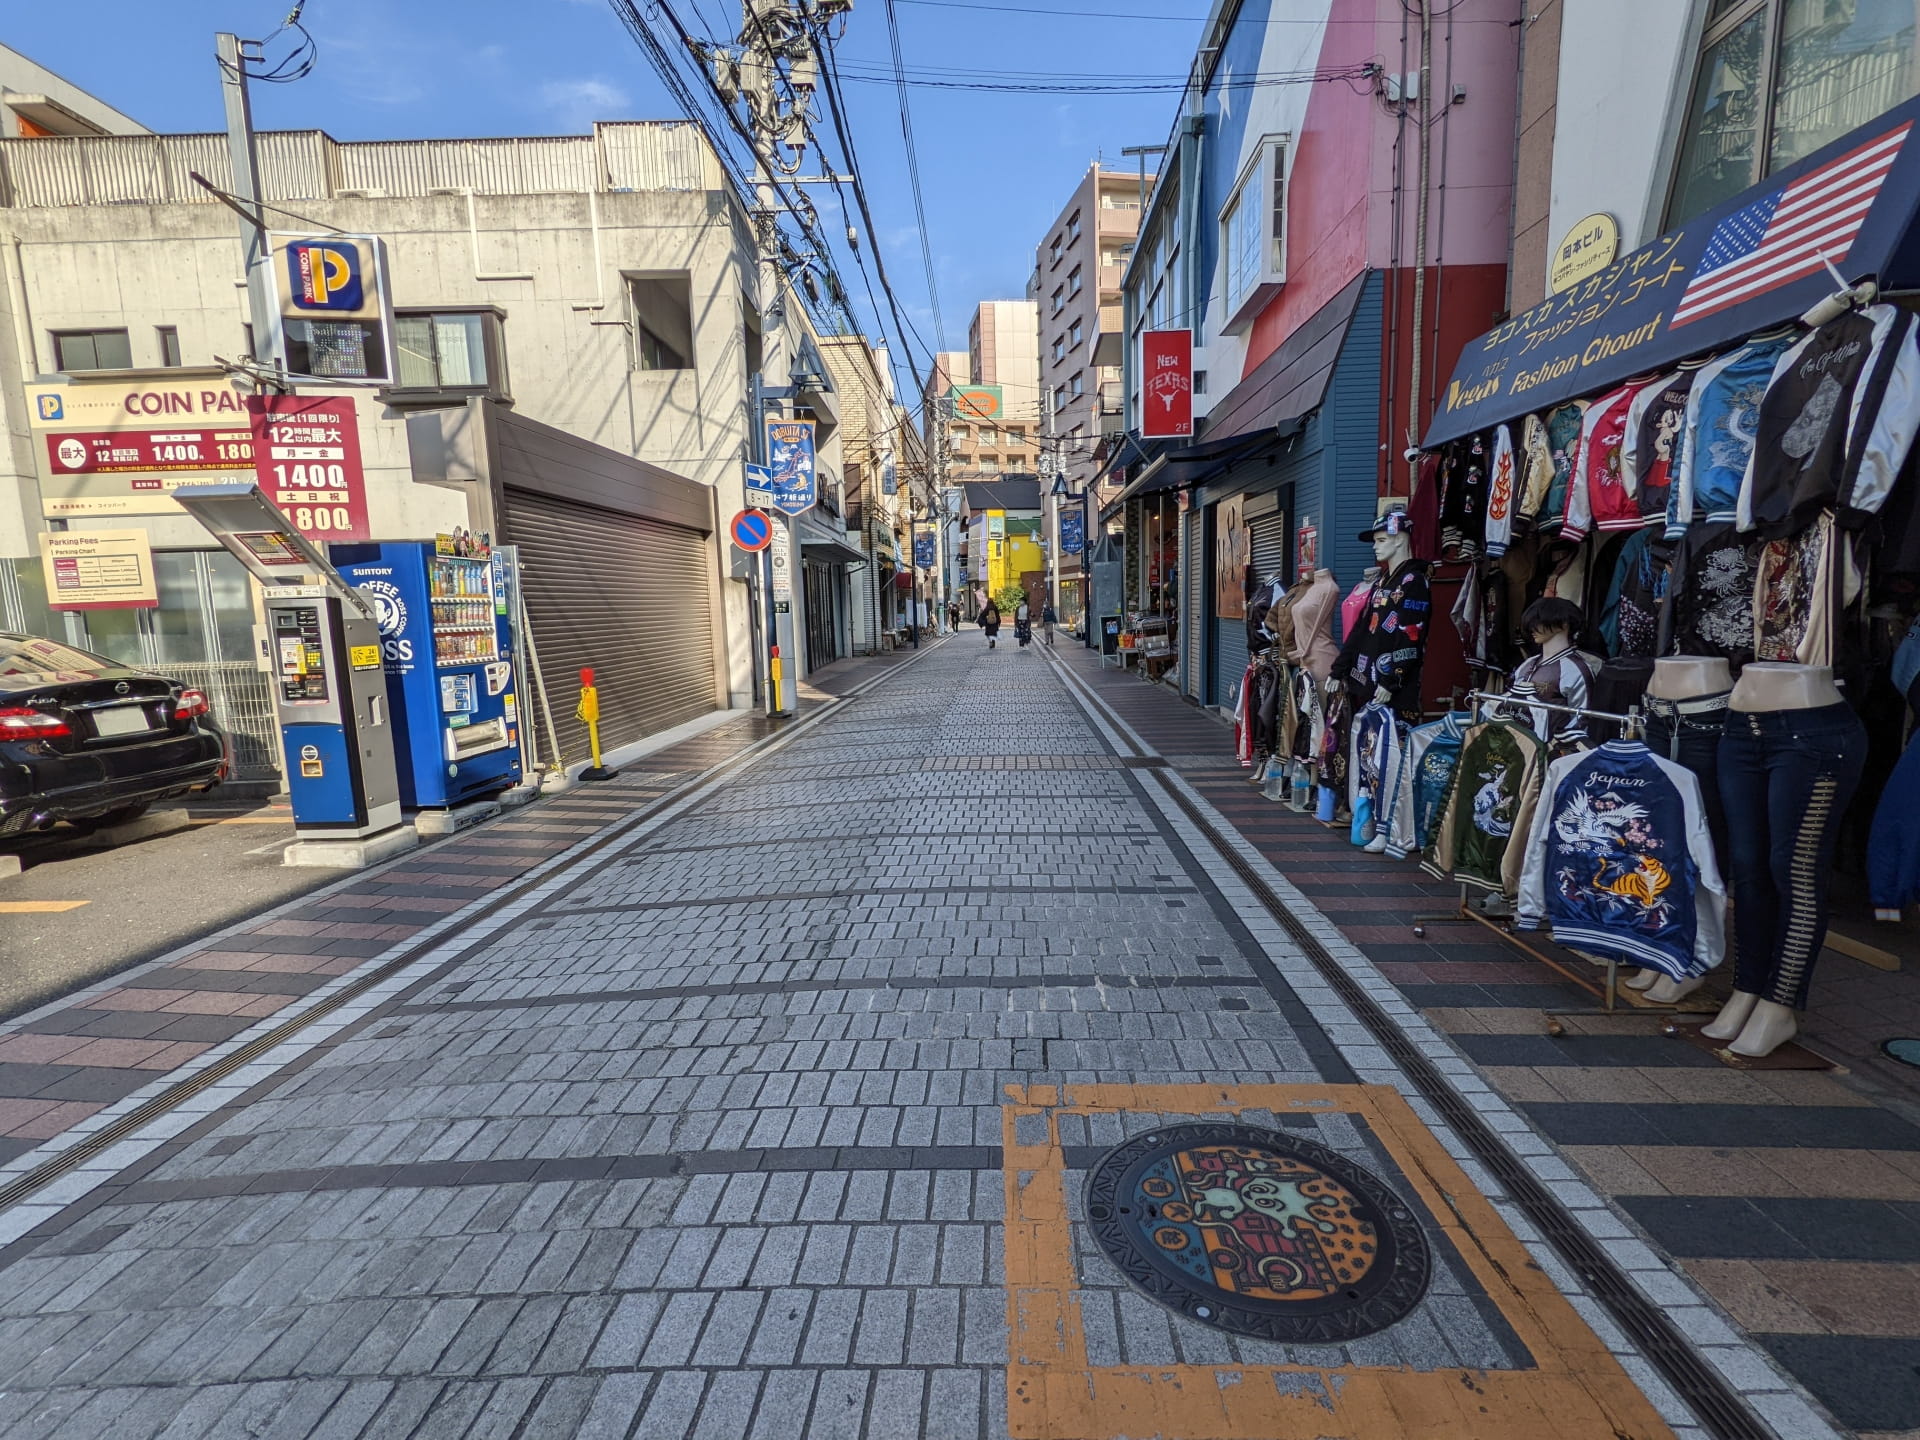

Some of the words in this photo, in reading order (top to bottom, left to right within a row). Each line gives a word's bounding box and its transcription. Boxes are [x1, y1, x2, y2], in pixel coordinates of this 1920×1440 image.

[1563, 226, 1603, 261] 岡本ビル
[300, 252, 310, 274] COIN
[302, 275, 313, 298] PARK
[1509, 354, 1578, 396] Fashion
[1582, 312, 1663, 366] Chourt
[1147, 371, 1189, 398] TEXAS
[124, 391, 193, 415] COIN
[200, 390, 250, 413] PAR
[771, 425, 800, 440] DOBUITA
[1176, 423, 1189, 432] 2F
[60, 447, 84, 460] 最大
[96, 450, 110, 462] 12
[353, 568, 392, 576] SUNTORY
[359, 581, 399, 598] OFFEE
[1404, 599, 1429, 611] EAST
[381, 639, 414, 661] SS
[1585, 771, 1653, 788] Japan
